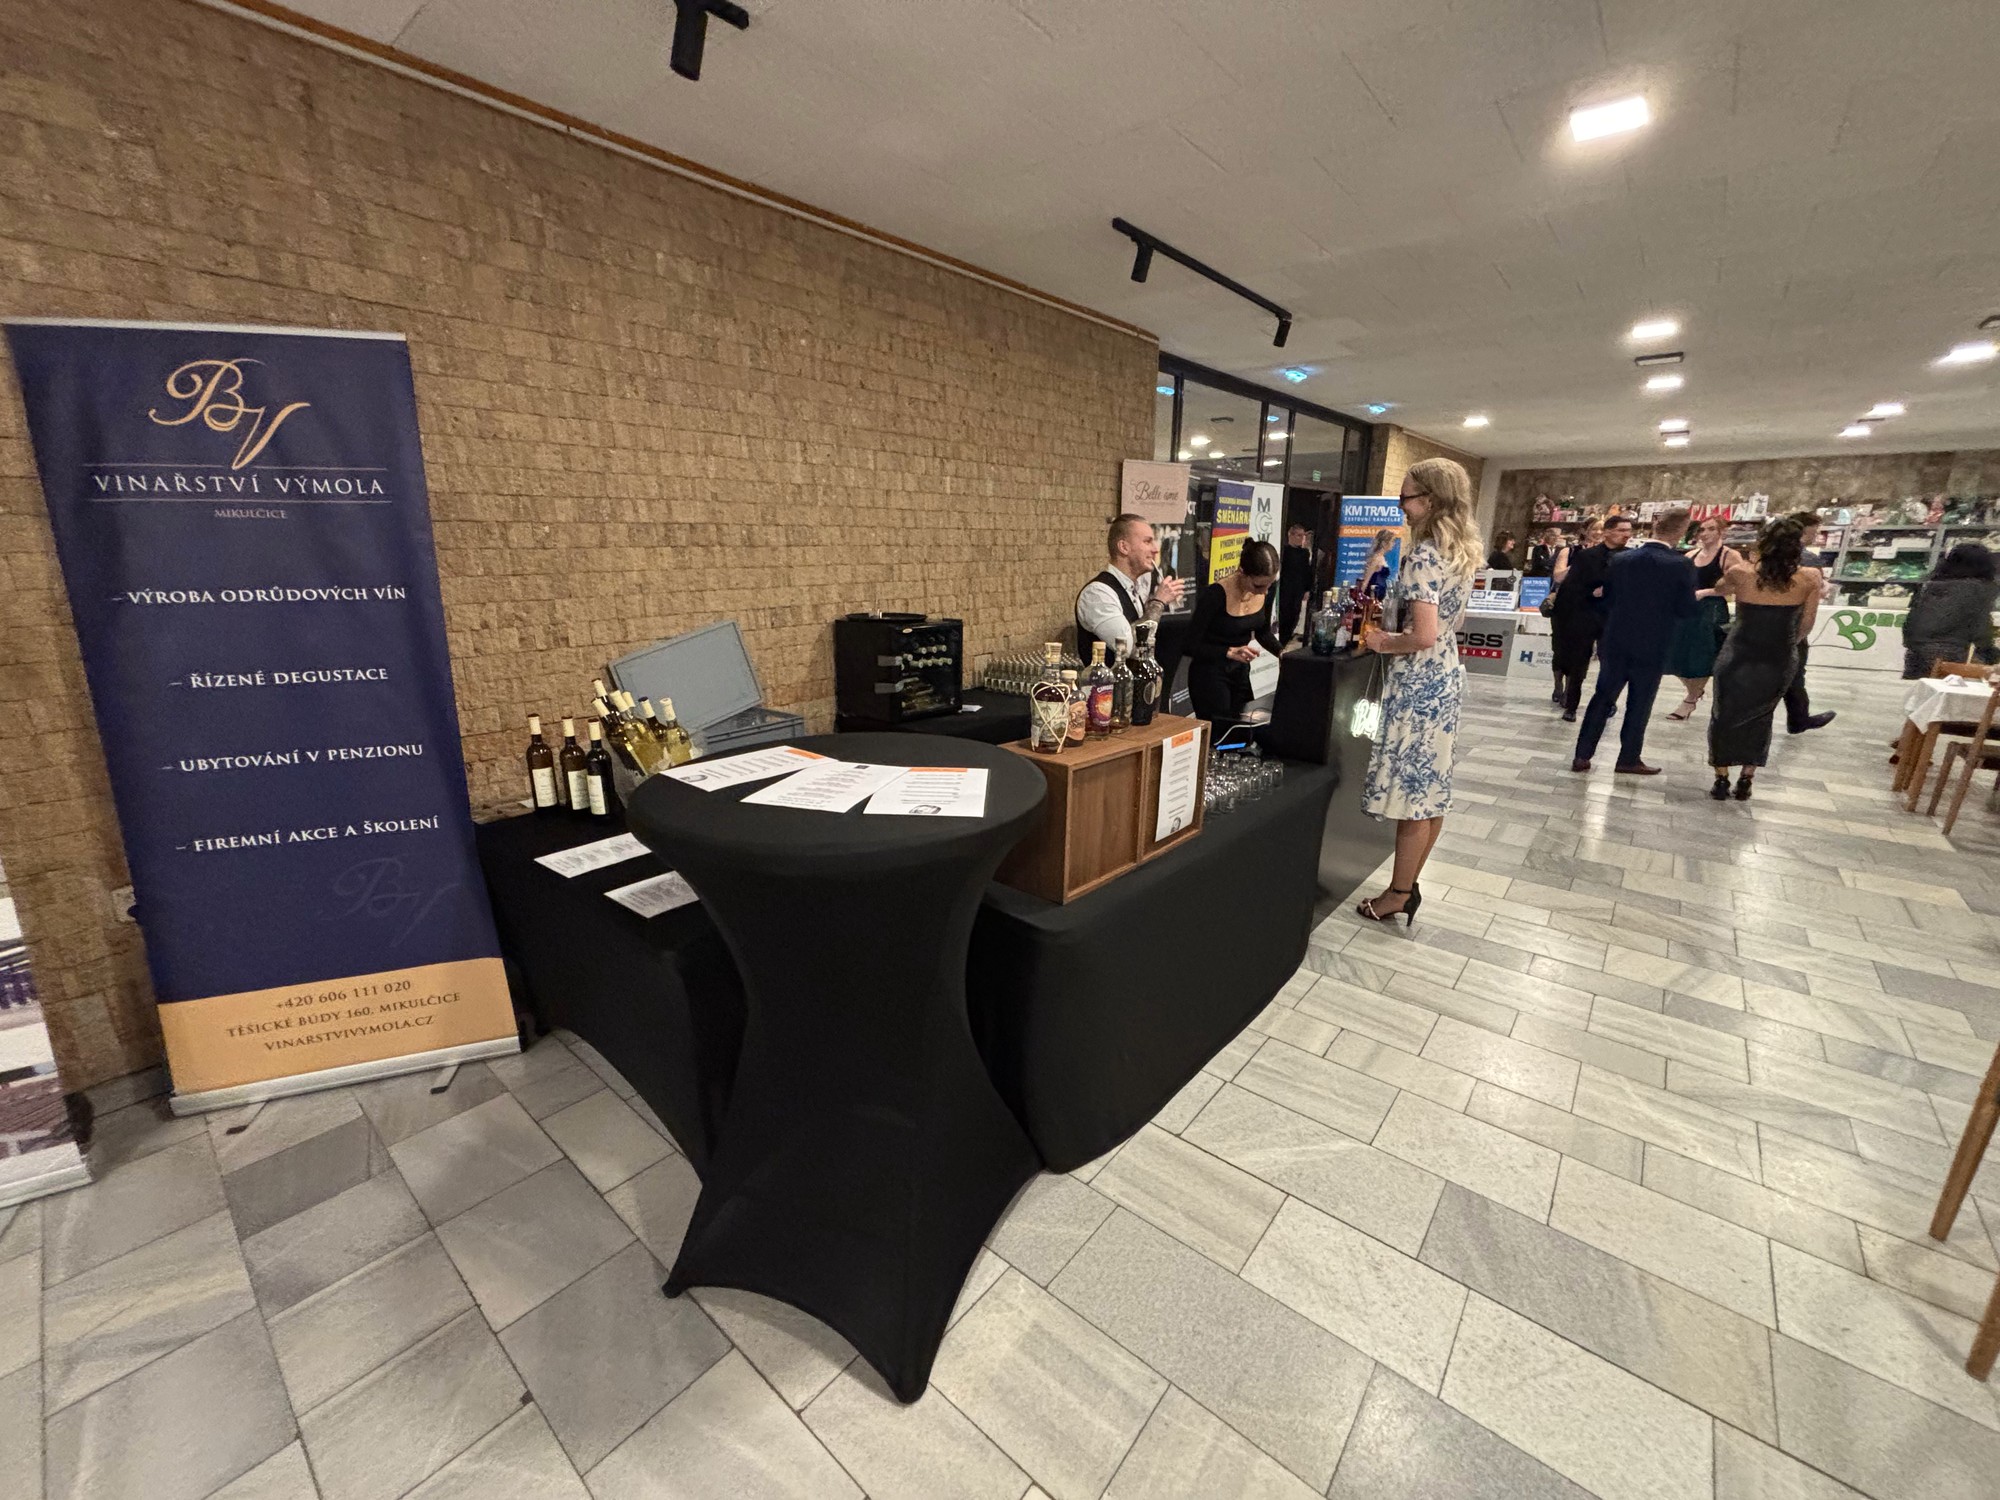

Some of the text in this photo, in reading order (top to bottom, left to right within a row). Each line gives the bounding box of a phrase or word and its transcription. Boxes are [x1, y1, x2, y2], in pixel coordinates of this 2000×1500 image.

[94, 473, 385, 495] VINAŘSTVÍ VÝMOLA
[1216, 506, 1250, 525] SMĚNÁRN
[1344, 505, 1400, 517] KM TRAVEL
[129, 585, 406, 605] VÝROBA ODRŮDOVÝCH VÍN
[190, 668, 389, 688] ŘÍZENÉ DEGUSTACE
[180, 744, 423, 772] UBYTOVÁNÍ V PENZIONU
[194, 815, 439, 851] FIREMNÍ AKCE A ŠKOLENÍ
[277, 980, 411, 1008] +420 606 111 020
